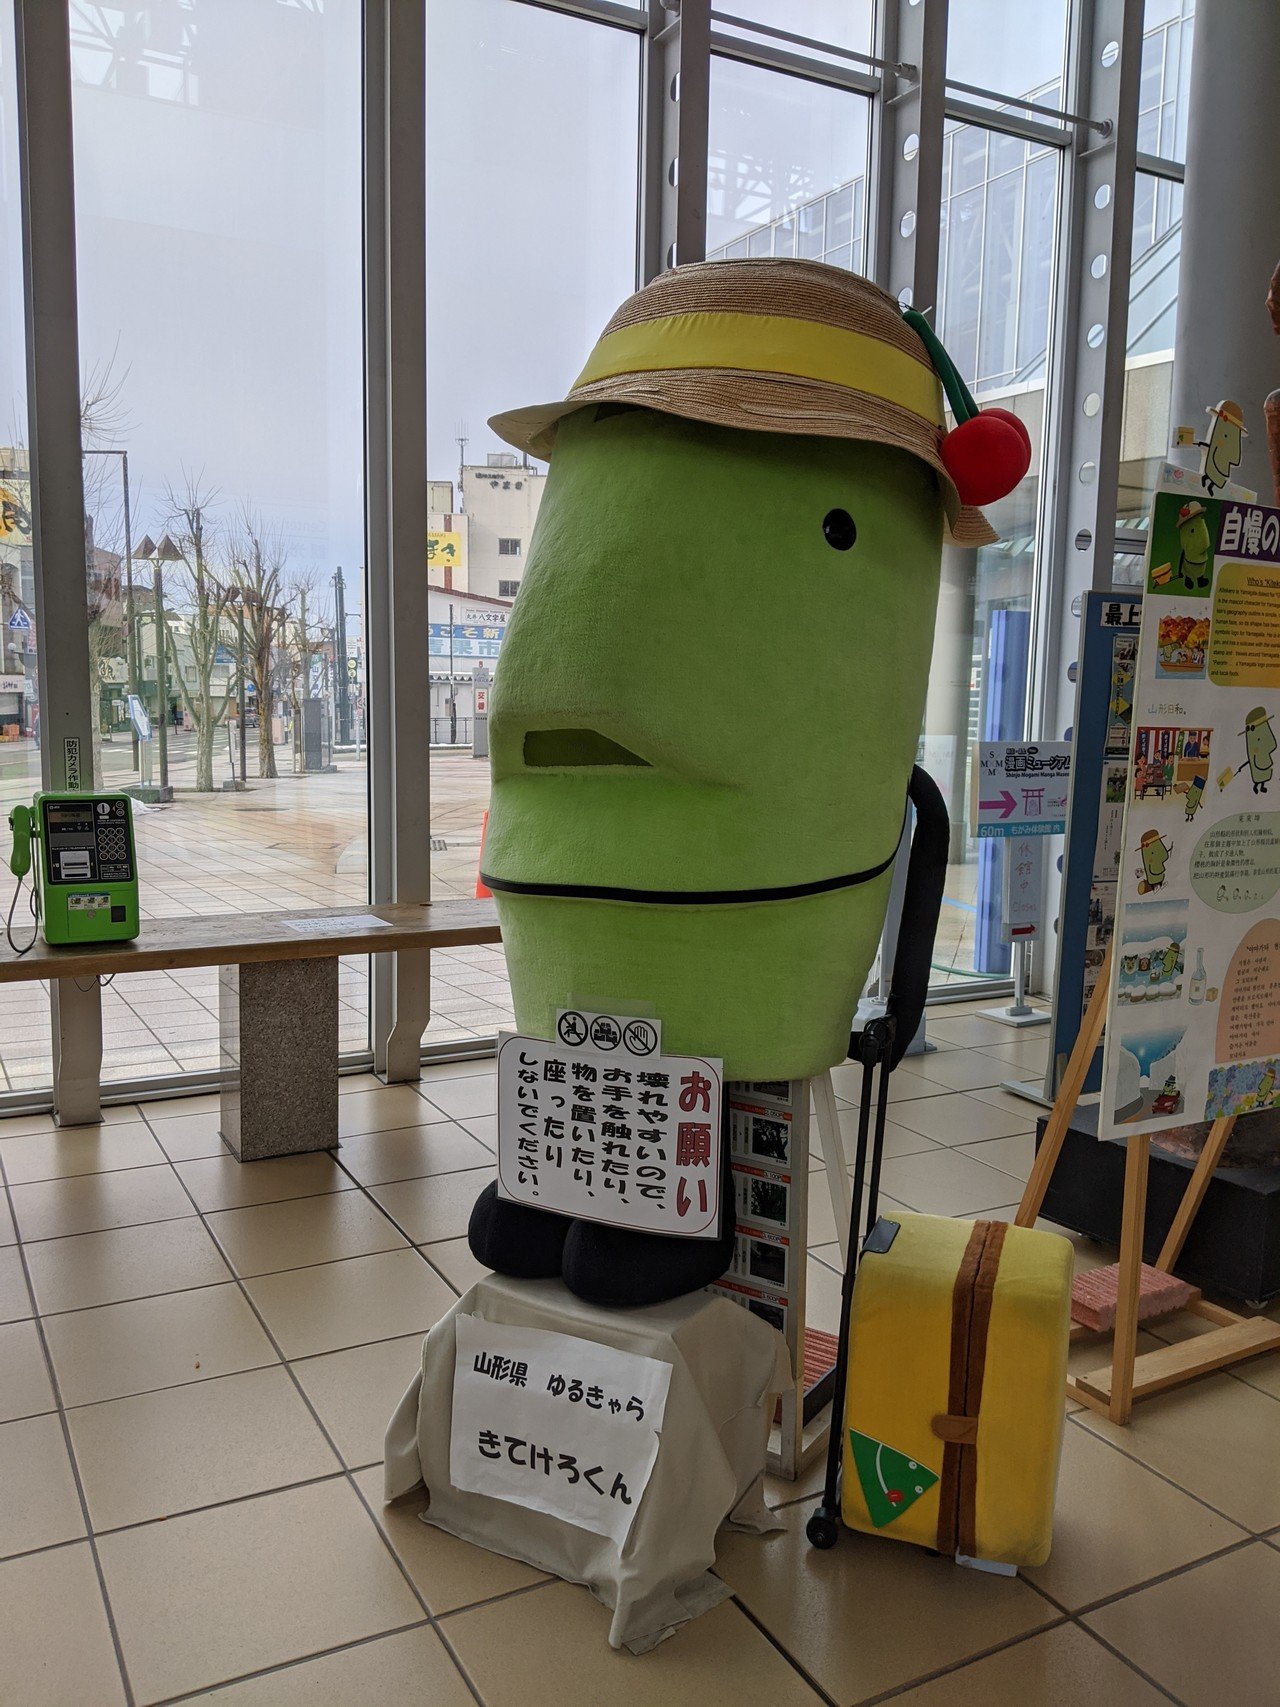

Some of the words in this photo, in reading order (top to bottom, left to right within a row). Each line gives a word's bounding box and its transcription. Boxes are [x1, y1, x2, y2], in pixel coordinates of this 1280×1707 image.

[1220, 506, 1280, 556] 自慢の
[479, 614, 506, 622] 八文字屋
[1105, 604, 1142, 626] 最上
[66, 740, 80, 790] 防犯カメラ作動
[980, 826, 1004, 837] 60m
[518, 1052, 539, 1196] しないでください。
[543, 1059, 567, 1168] 座ったり
[570, 1062, 598, 1198] 物を置いたり、
[601, 1068, 633, 1204] お手を触れたり、
[636, 1072, 670, 1210] 壊れやすいので、
[676, 1071, 712, 1217] お願い
[473, 1352, 529, 1387] 山形県
[546, 1374, 645, 1422] ゆるきゃら
[478, 1430, 633, 1505] きてけろくん
